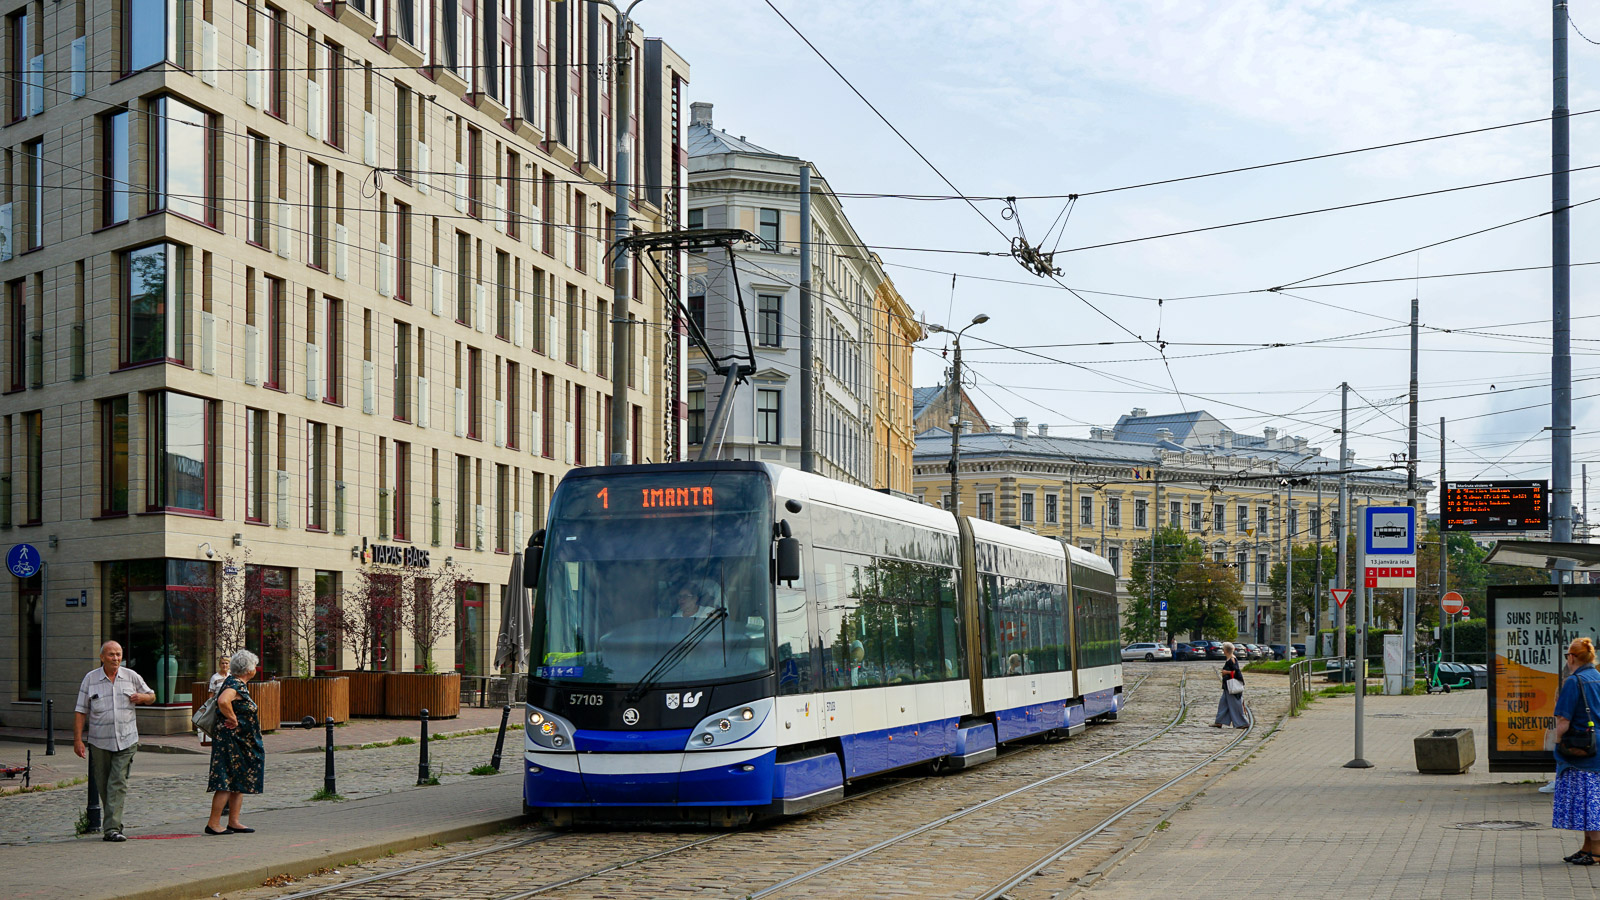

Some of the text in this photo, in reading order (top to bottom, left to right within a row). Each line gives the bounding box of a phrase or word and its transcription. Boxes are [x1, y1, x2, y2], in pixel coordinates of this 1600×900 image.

[597, 488, 608, 508] 1
[642, 487, 712, 507] IMANTA
[372, 544, 402, 564] TAPAS
[1507, 612, 1530, 624] SUNS
[1507, 628, 1528, 646] MĒS
[1507, 647, 1550, 664] PALĪGĀ!
[570, 694, 603, 705] 57103
